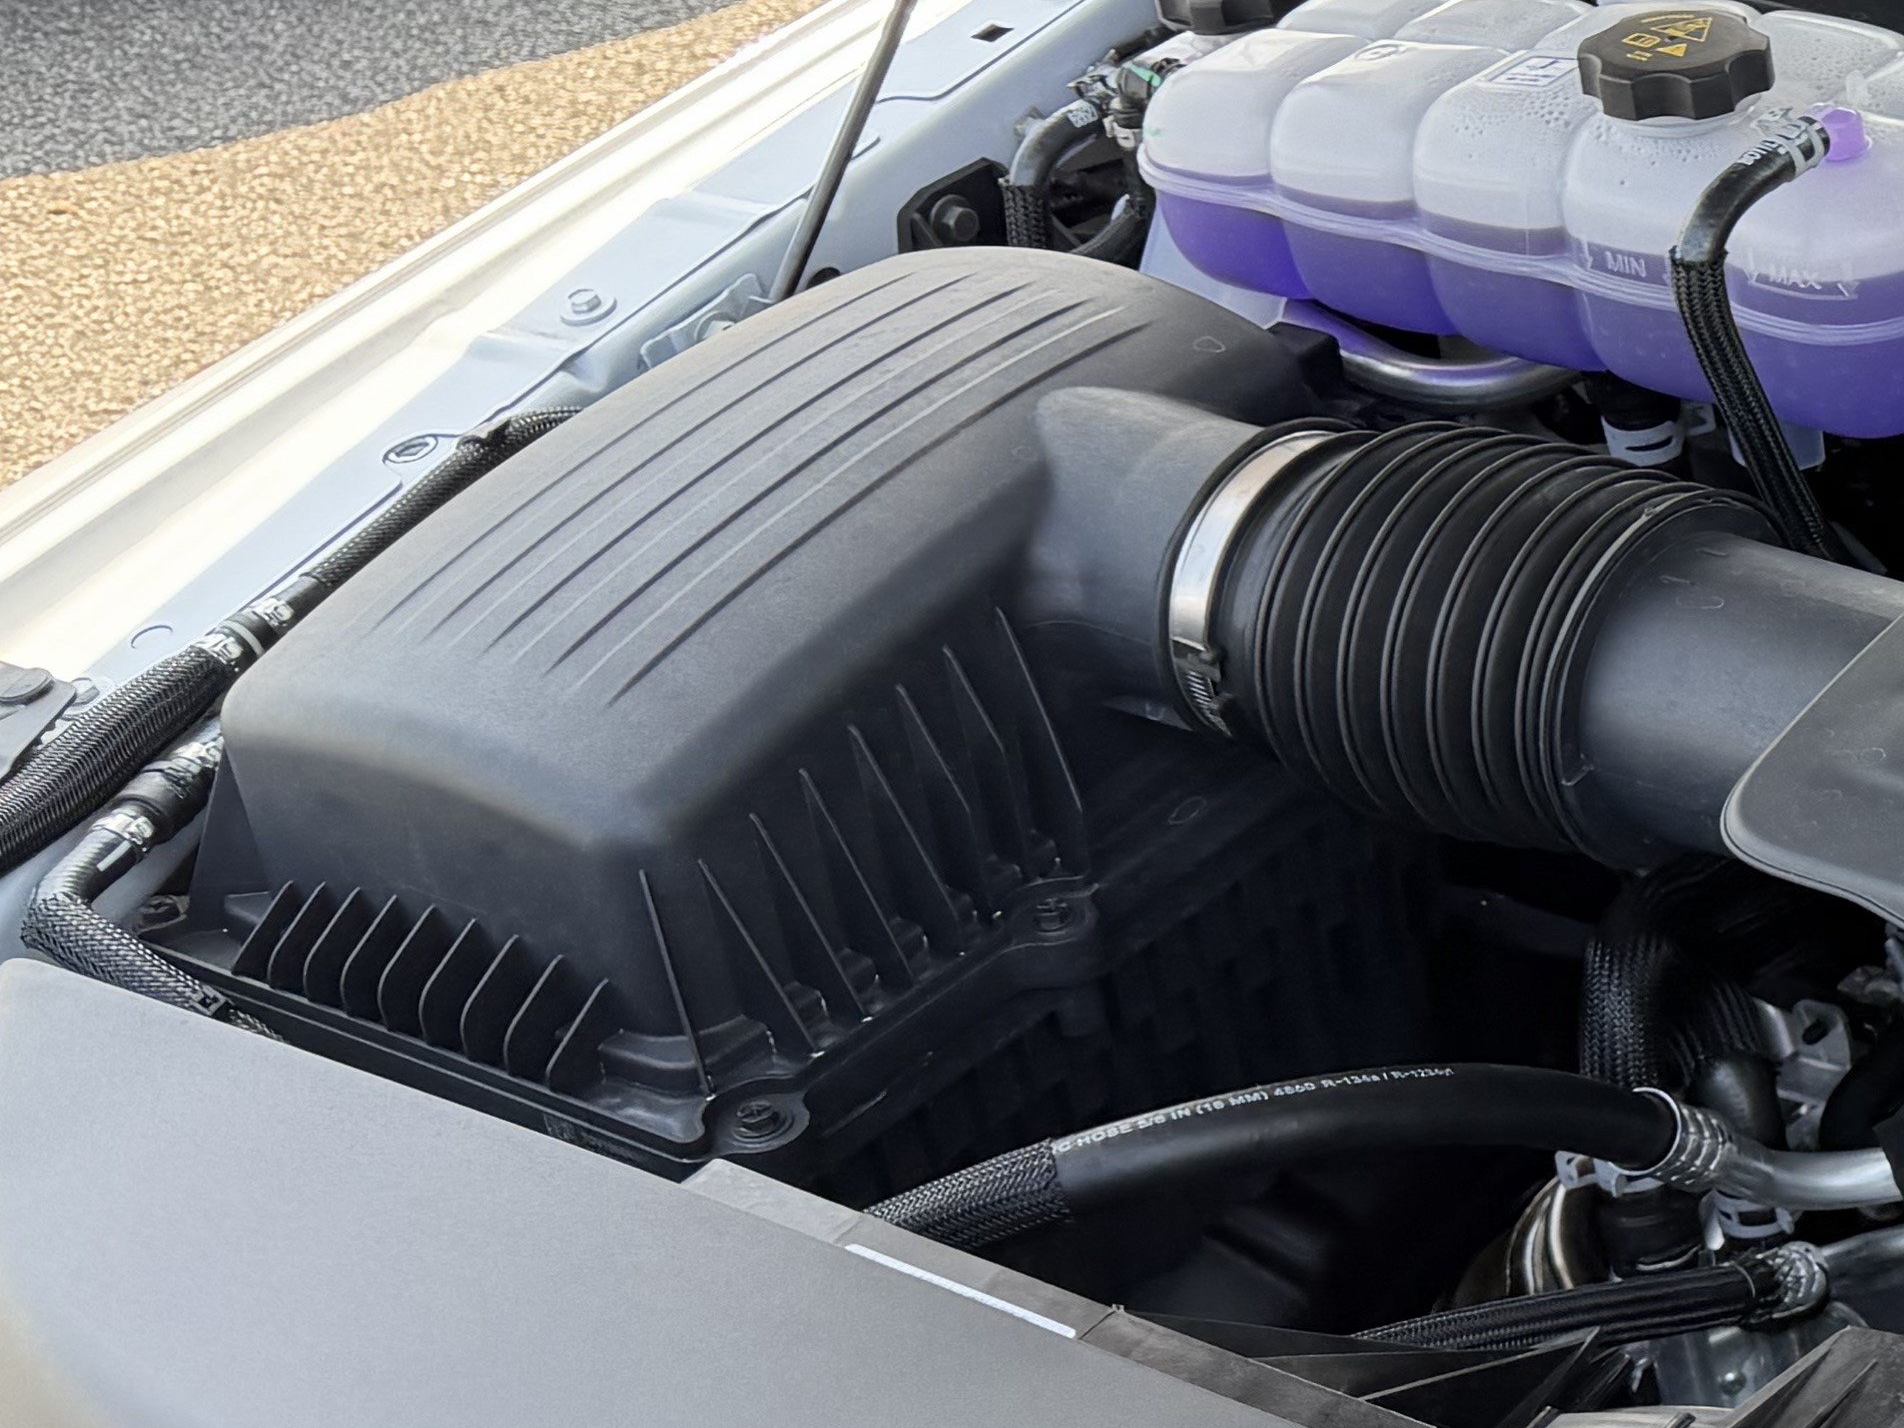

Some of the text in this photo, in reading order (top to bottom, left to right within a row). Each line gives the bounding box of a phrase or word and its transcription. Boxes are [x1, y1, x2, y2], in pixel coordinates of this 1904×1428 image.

[1605, 251, 1647, 278] MIN
[1769, 264, 1822, 290] MAX
[1076, 1124, 1133, 1148] HOSE
[1170, 1106, 1191, 1120] IN
[1228, 1091, 1269, 1107] MM)
